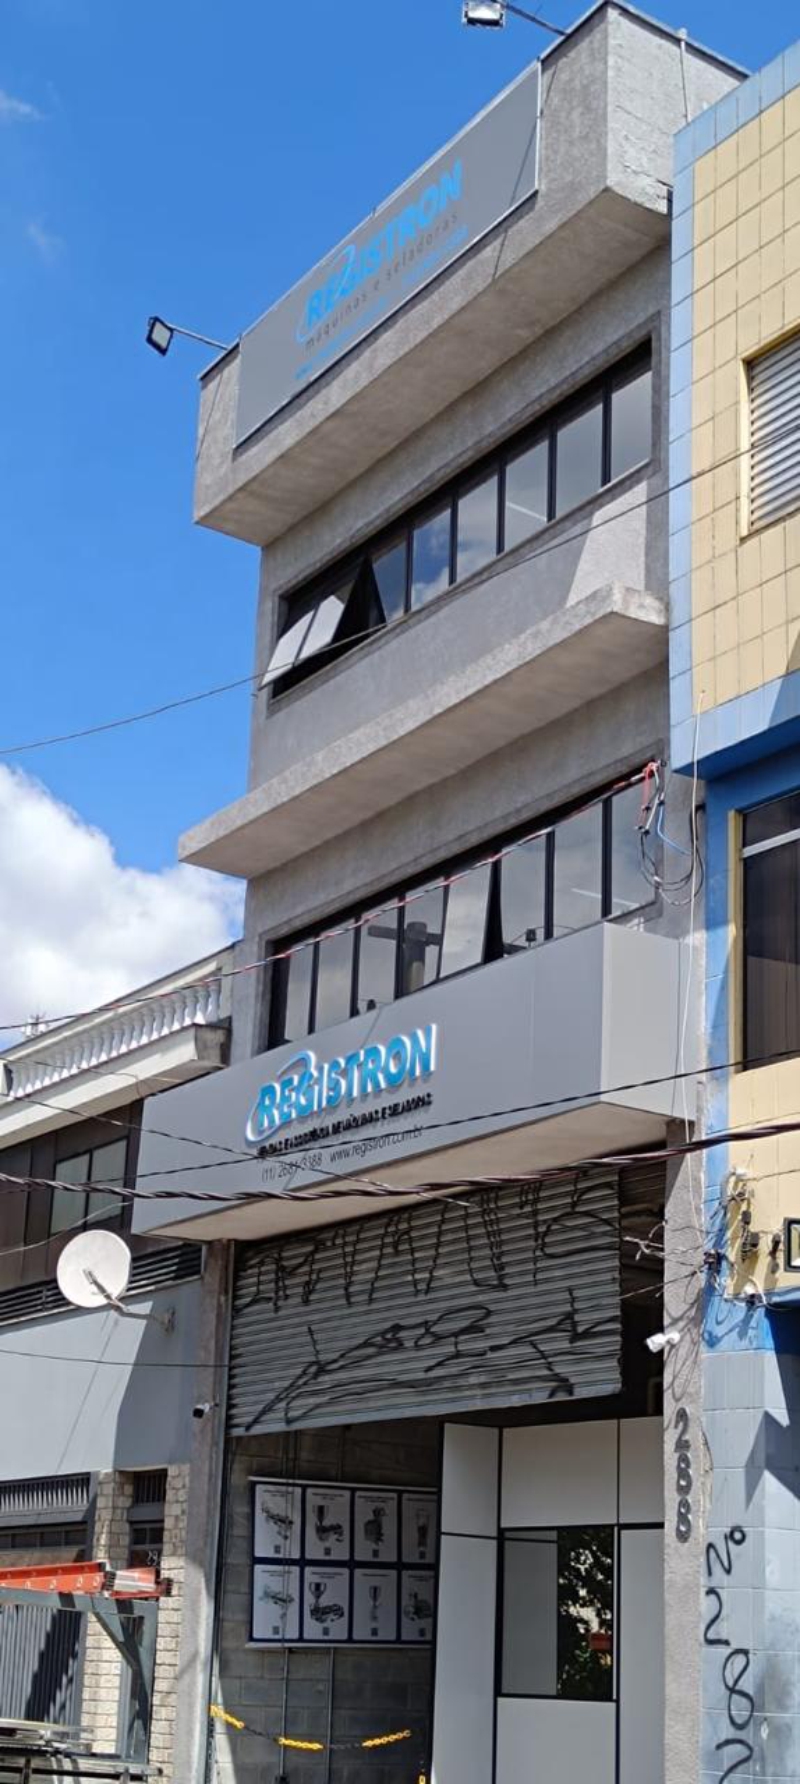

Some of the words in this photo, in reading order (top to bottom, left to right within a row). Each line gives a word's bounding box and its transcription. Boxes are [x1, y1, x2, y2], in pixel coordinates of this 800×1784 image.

[301, 155, 463, 336] REGISTRON
[246, 1023, 437, 1143] REGISTRON
[673, 1405, 693, 1544] 288
